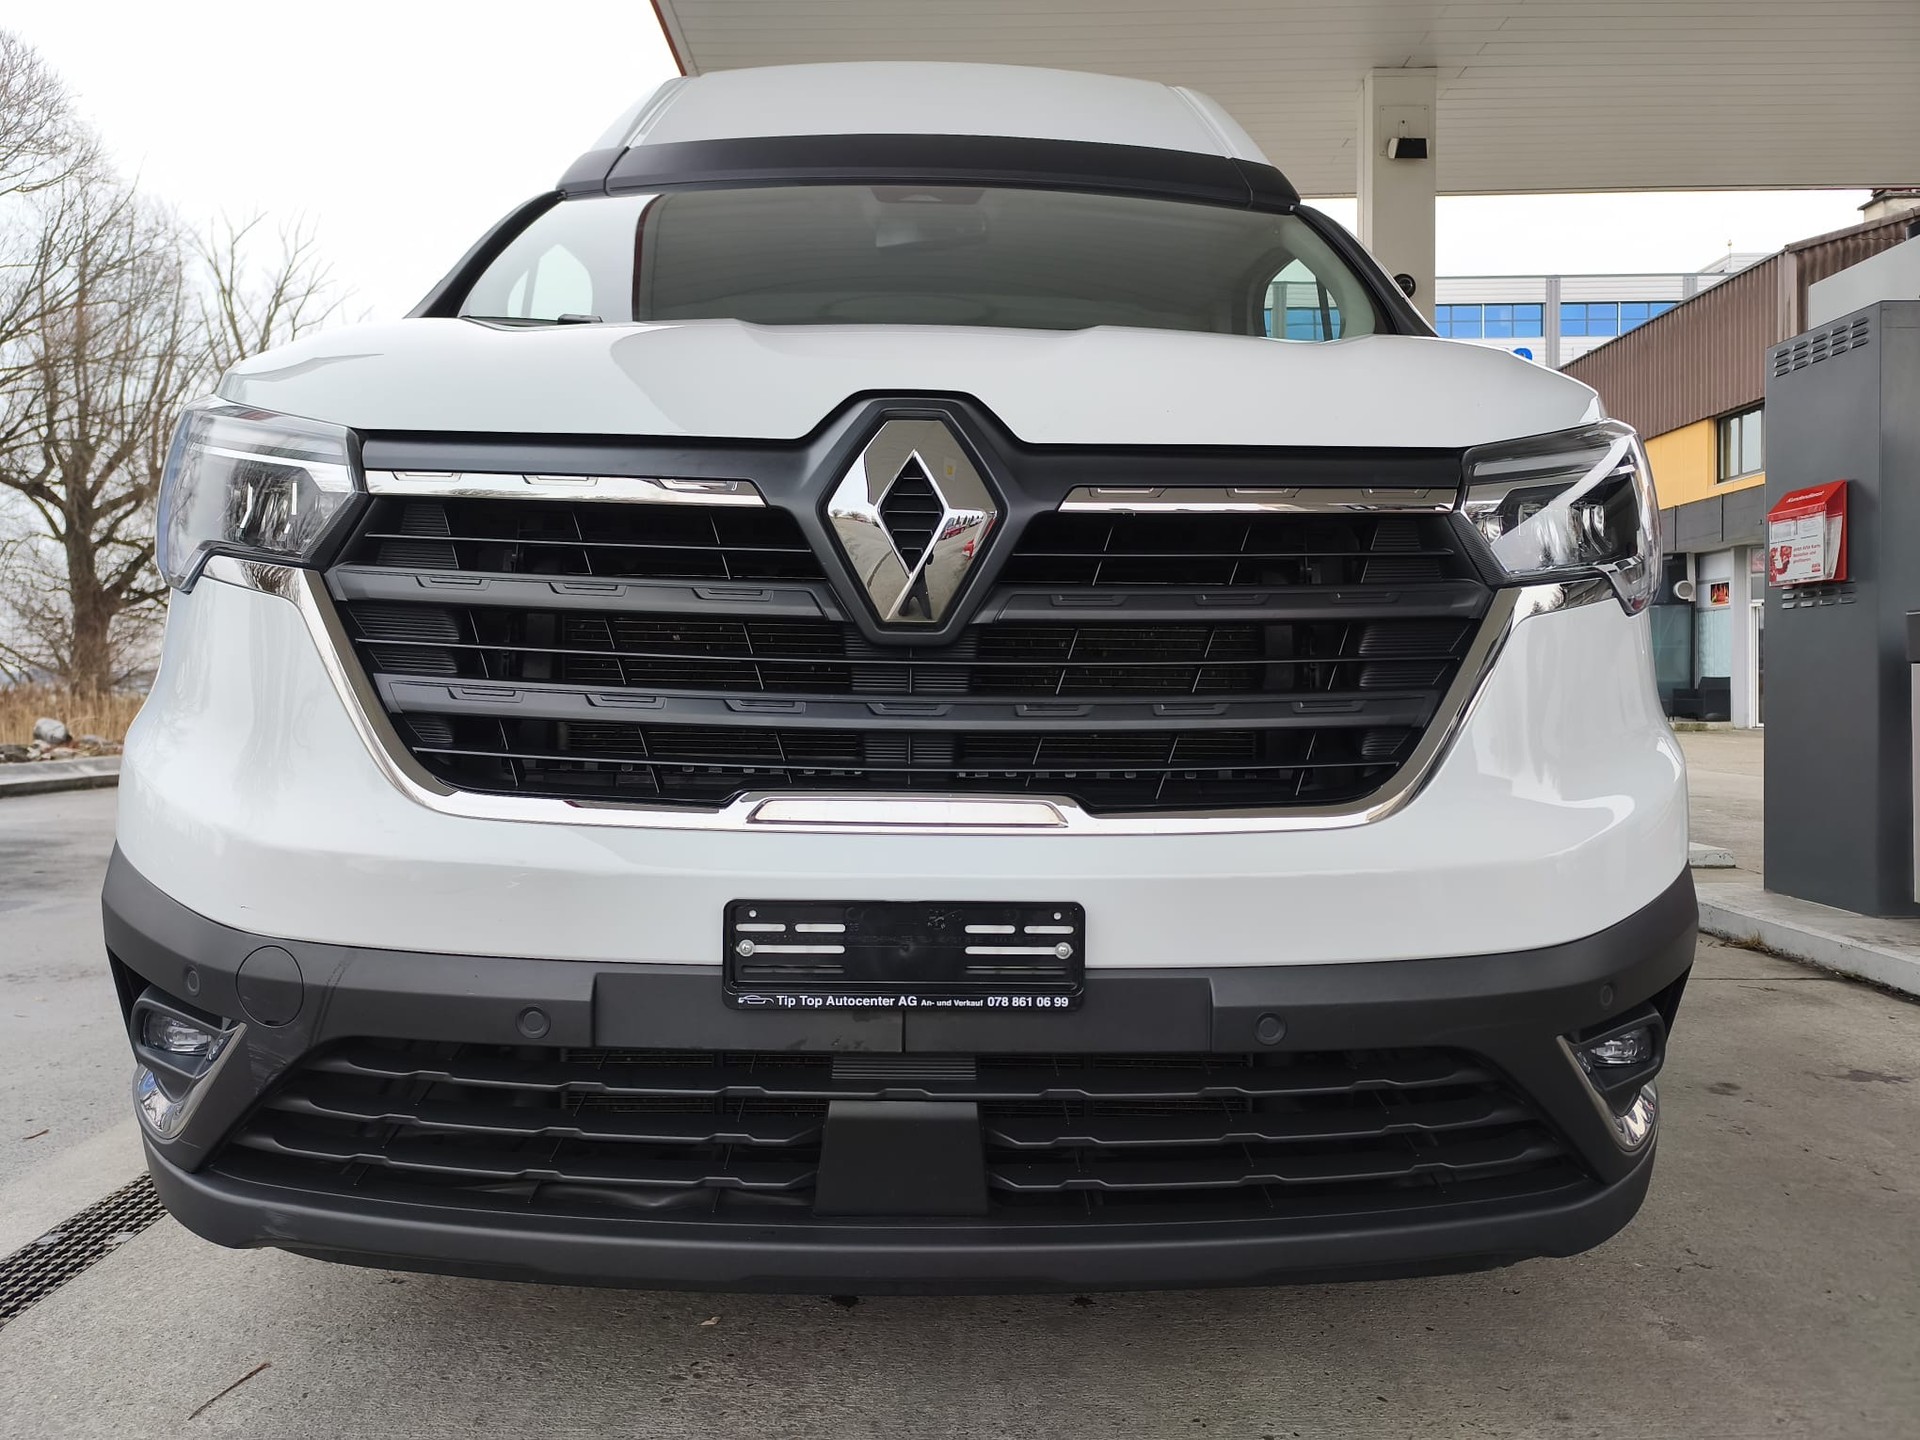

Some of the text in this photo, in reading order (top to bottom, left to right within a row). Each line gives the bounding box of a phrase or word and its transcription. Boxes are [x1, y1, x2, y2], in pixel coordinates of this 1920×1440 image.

[776, 995, 1069, 1008] Tip Top Autocenter AG An- und Verkauf 078 861 06 99
